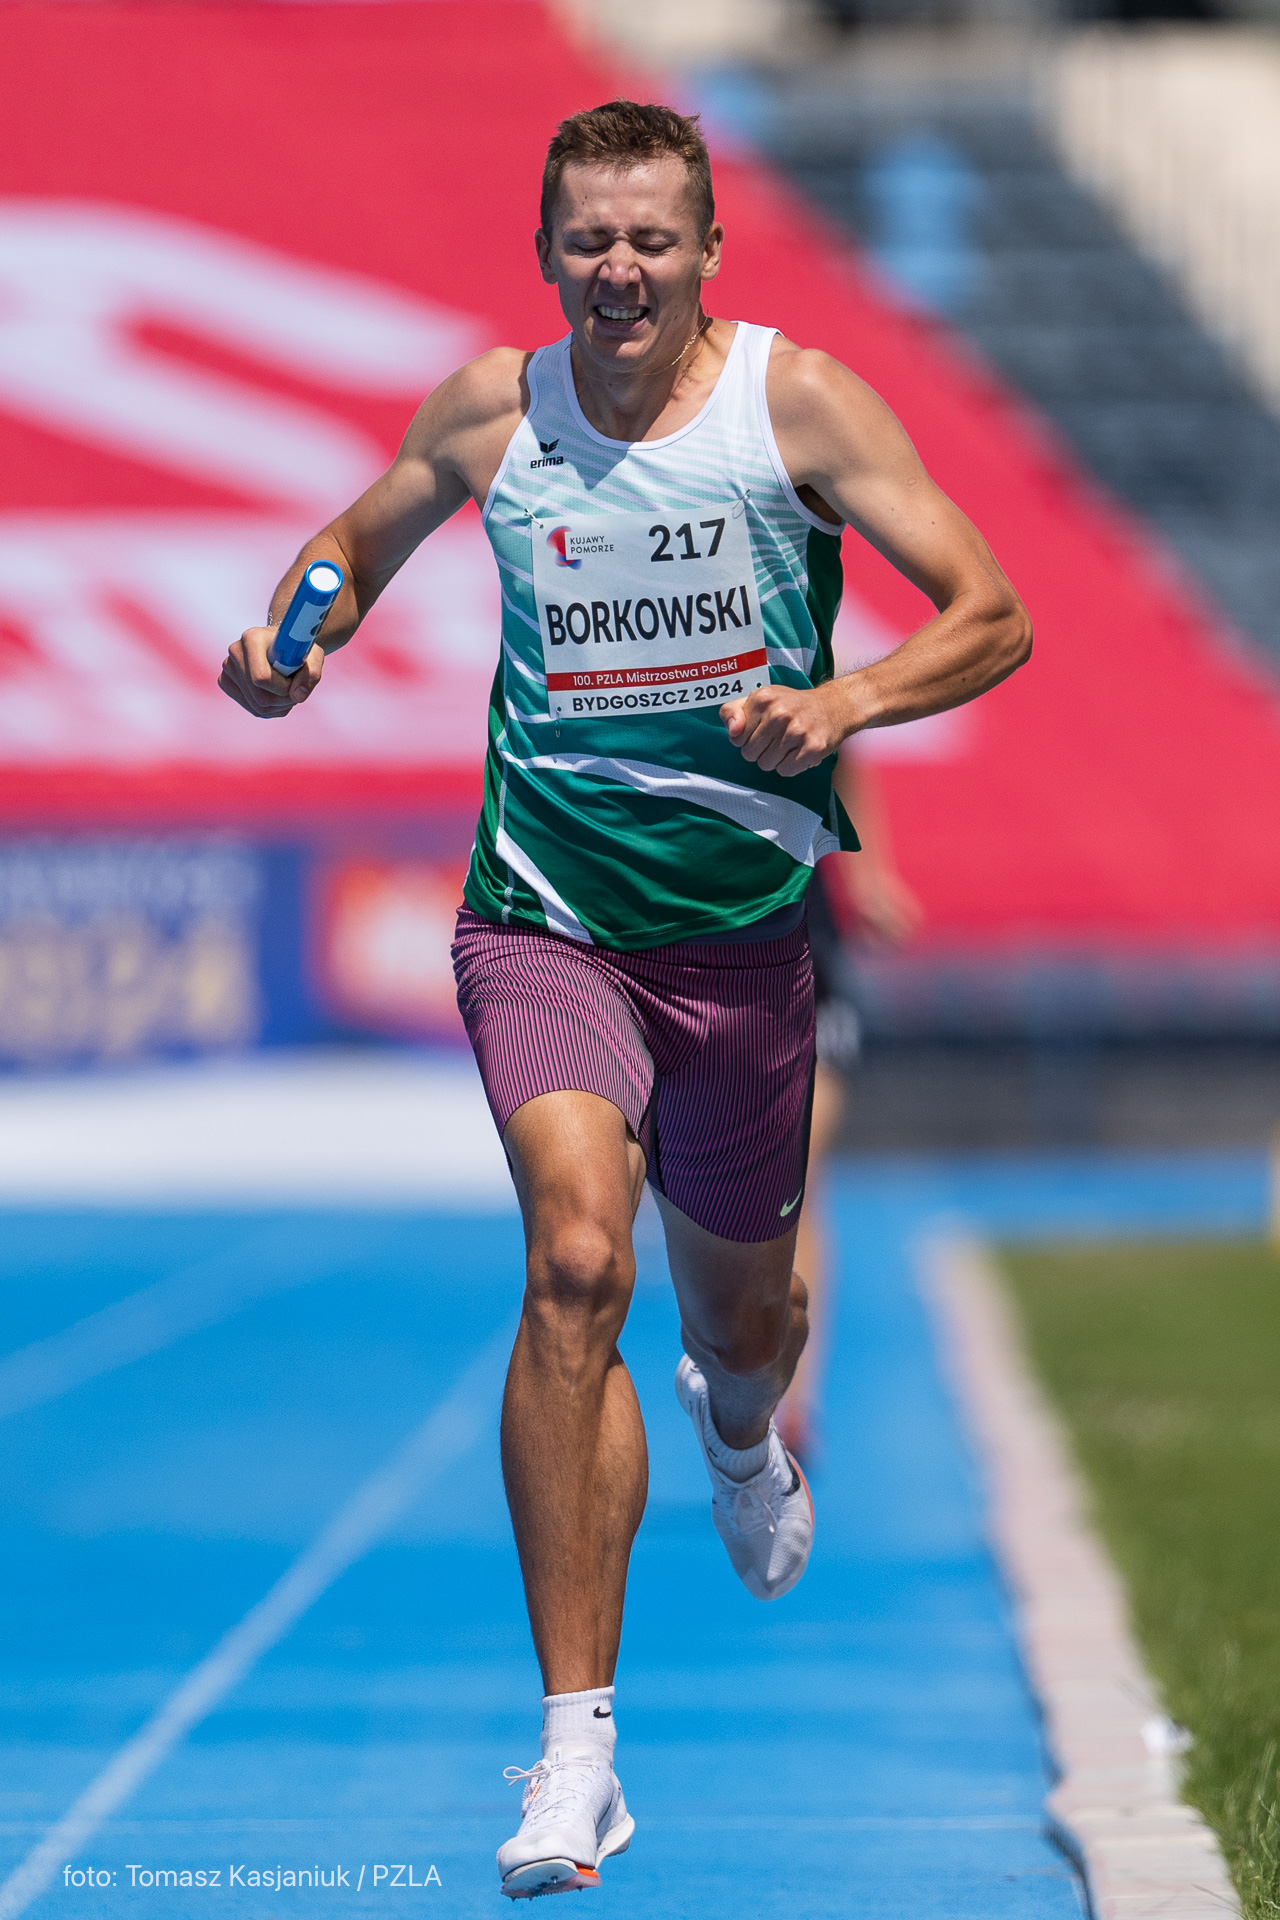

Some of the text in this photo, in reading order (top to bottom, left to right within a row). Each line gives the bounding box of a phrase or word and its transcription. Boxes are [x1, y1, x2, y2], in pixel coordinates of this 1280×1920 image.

[530, 455, 564, 469] erima
[570, 535, 605, 545] KUJAWY
[570, 544, 615, 554] POMORZE
[648, 518, 726, 562] 217
[545, 585, 752, 646] BORKOWSKI
[573, 659, 738, 687] 100. PZLA Mistrzostwa Polski
[573, 679, 744, 712] BYDGOSZCZ 2024
